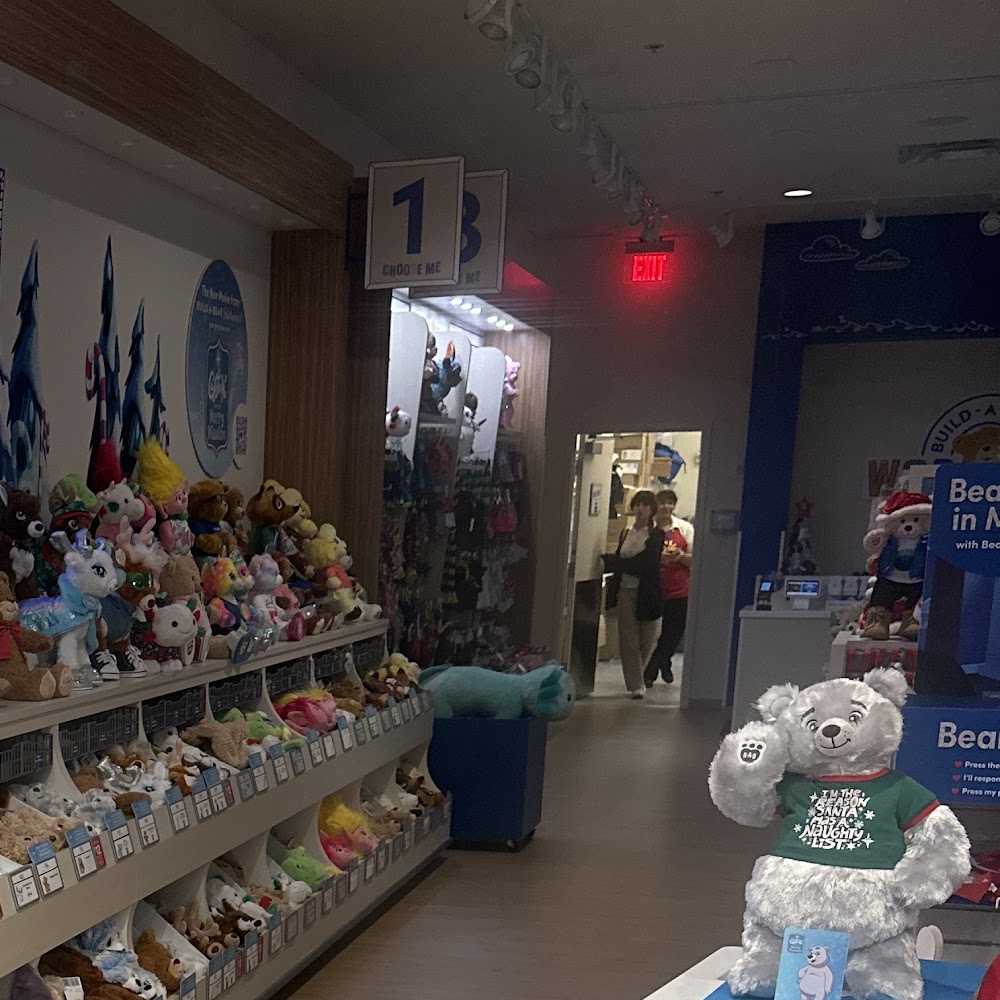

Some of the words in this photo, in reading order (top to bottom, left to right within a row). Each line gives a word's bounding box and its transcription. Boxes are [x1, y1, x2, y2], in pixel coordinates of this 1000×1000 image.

[393, 177, 425, 254] 1
[425, 261, 442, 275] ME
[632, 254, 667, 281] EXIT
[952, 506, 977, 531] in
[955, 540, 978, 550] with
[937, 721, 1000, 750] Bea
[964, 760, 986, 769] Press
[961, 787, 982, 796] Press
[984, 789, 997, 798] my
[815, 796, 871, 808] REASON
[816, 805, 858, 818] SANTA
[836, 816, 850, 829] A
